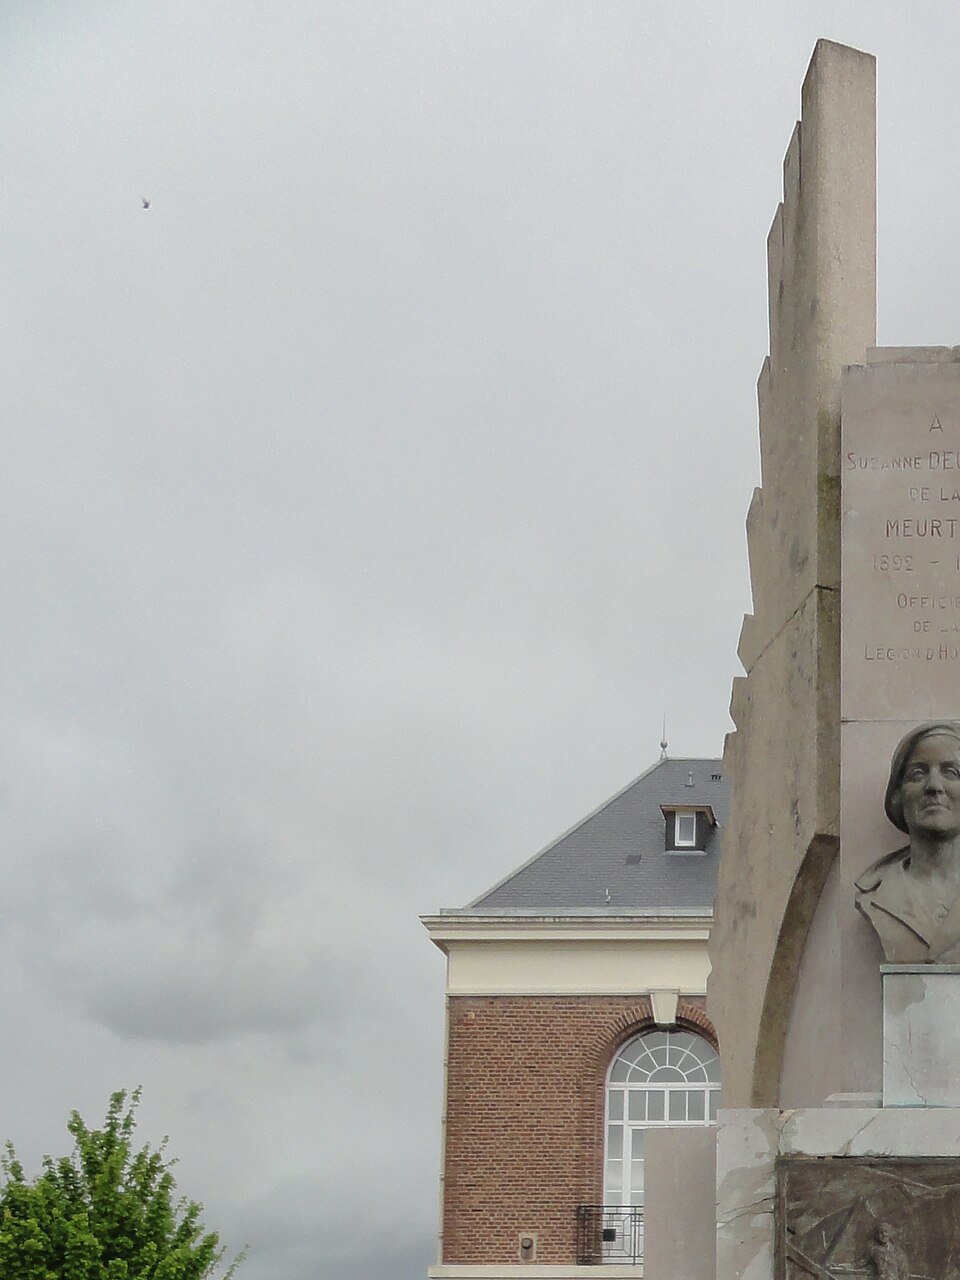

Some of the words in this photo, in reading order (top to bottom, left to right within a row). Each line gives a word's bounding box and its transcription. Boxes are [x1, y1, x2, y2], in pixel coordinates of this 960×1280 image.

[929, 413, 944, 433] A
[909, 488, 930, 501] DE
[913, 621, 930, 633] DE
